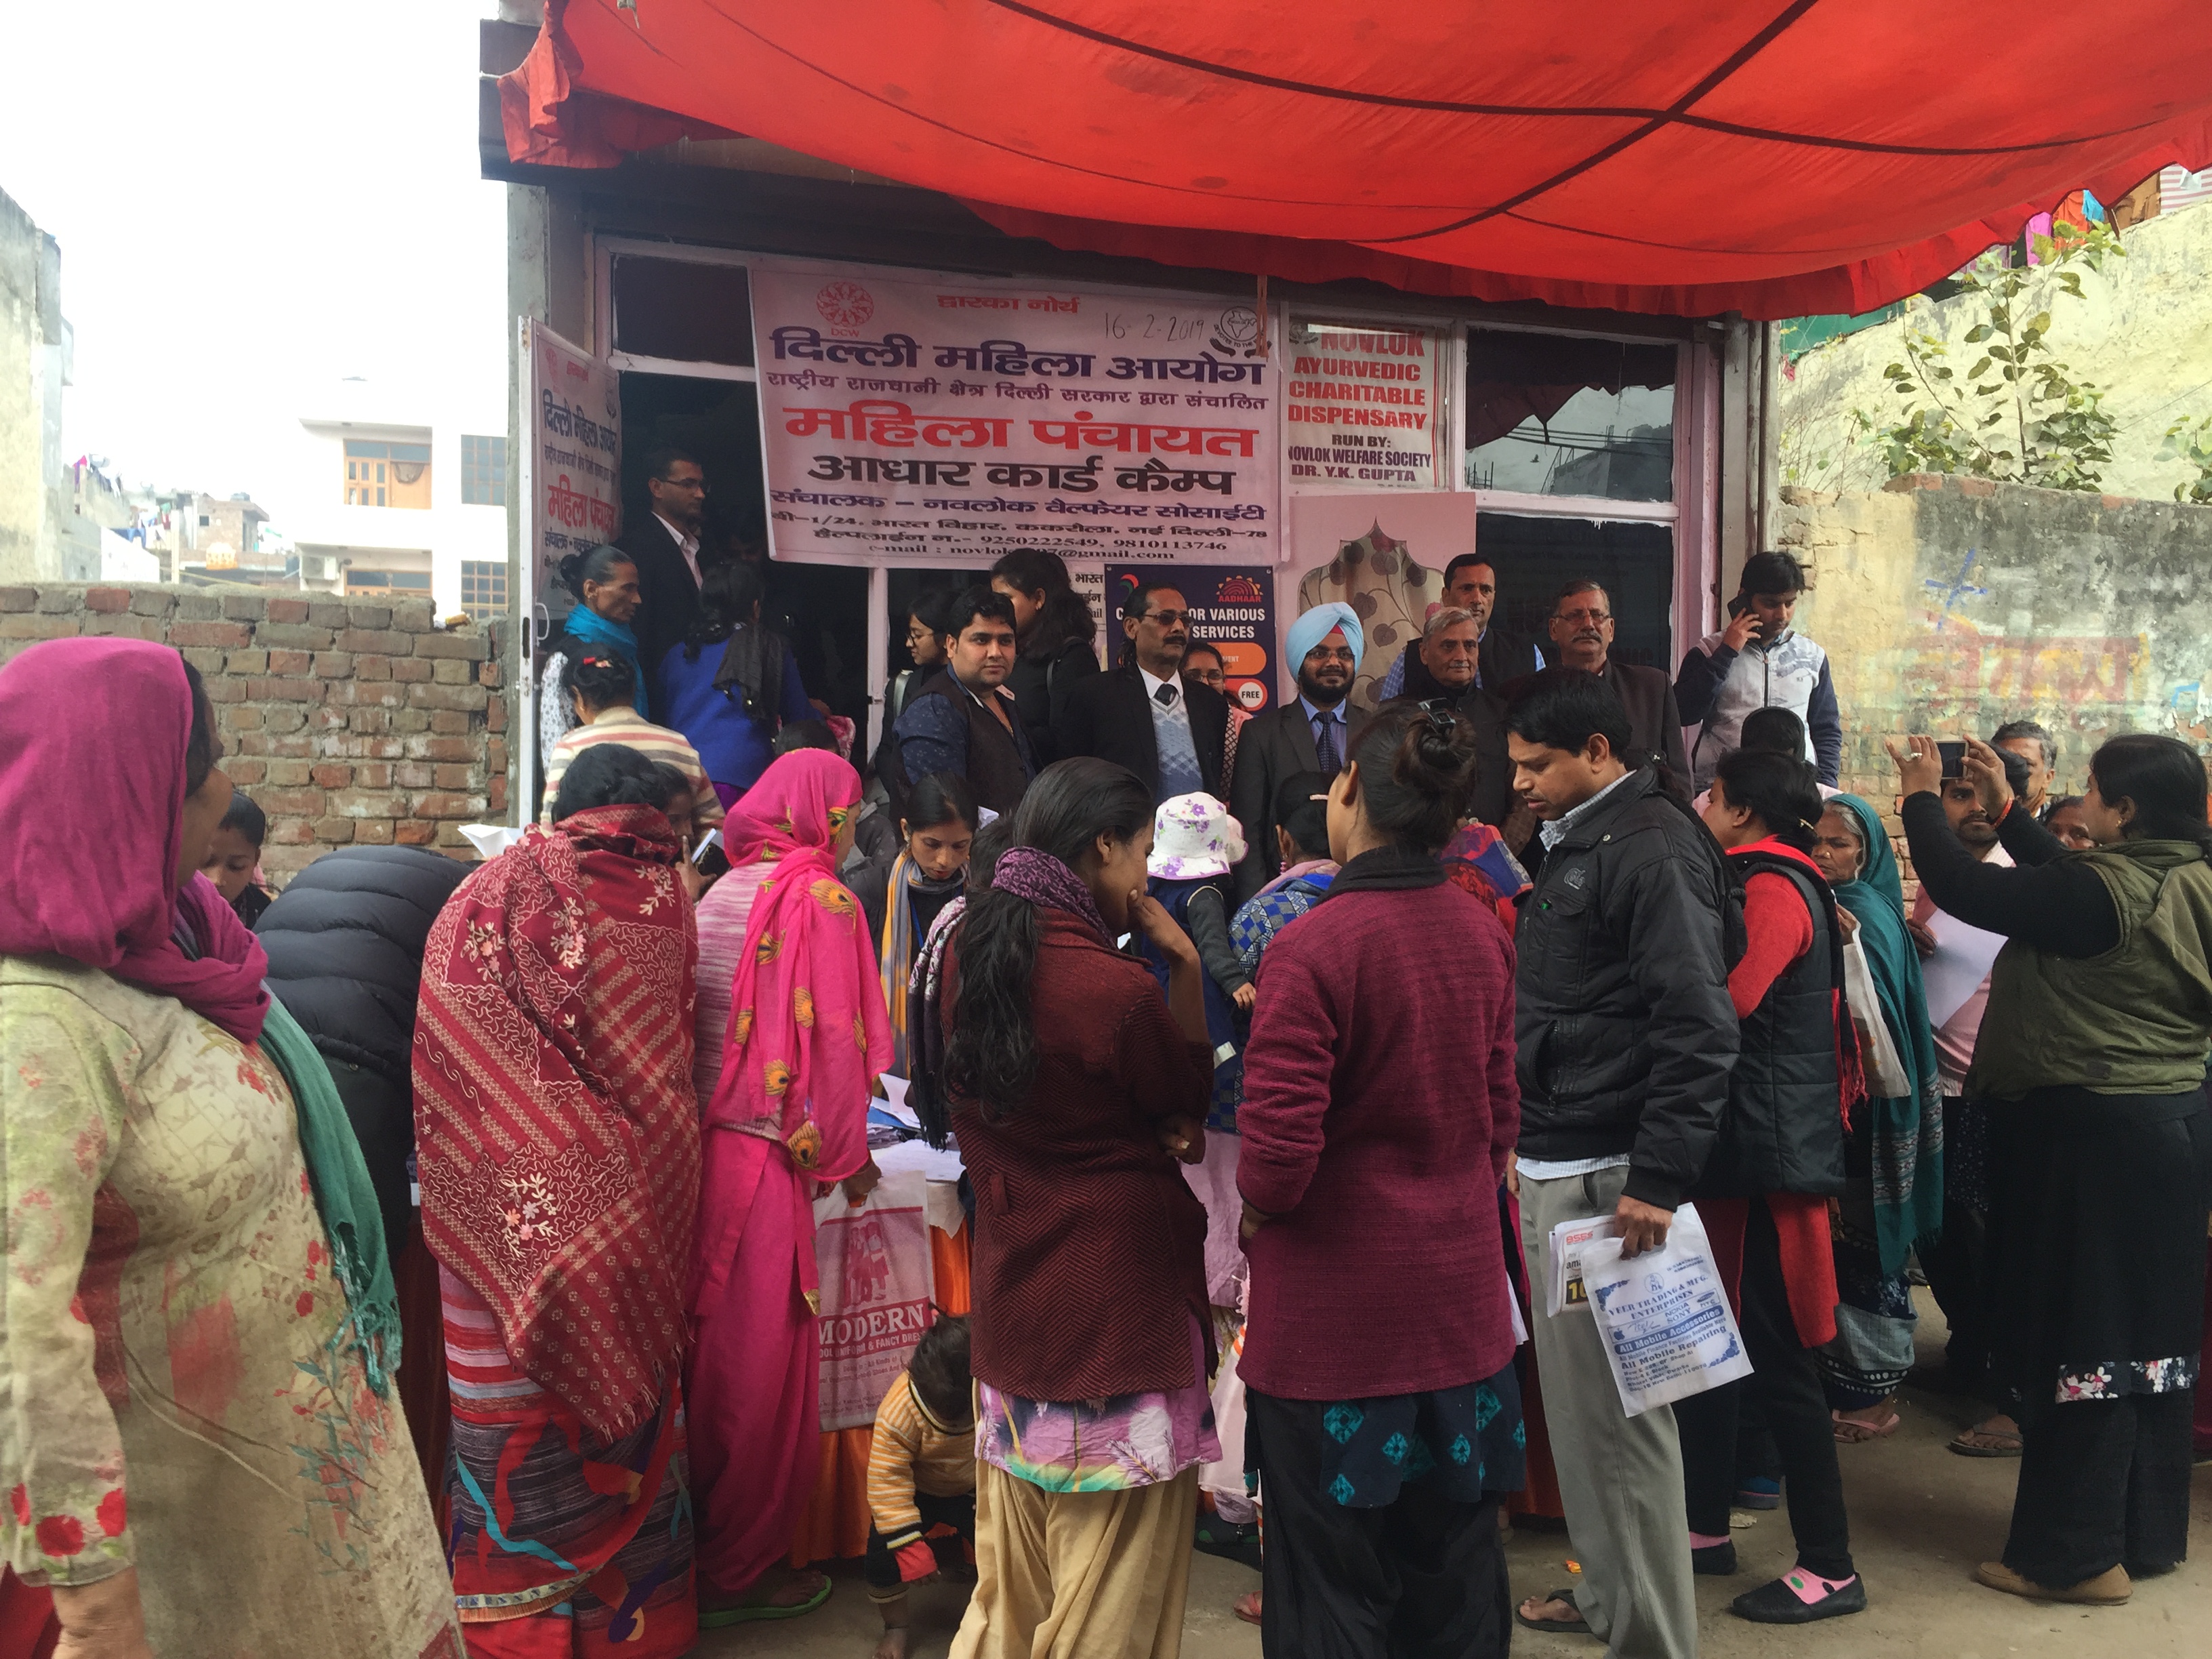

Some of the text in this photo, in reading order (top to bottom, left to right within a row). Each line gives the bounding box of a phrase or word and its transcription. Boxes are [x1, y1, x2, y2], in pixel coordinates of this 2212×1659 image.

[831, 328, 859, 337] DCW
[1322, 327, 1425, 357] NOVLOK
[769, 325, 1266, 385] दिल्ली महिला आयोग
[1294, 356, 1420, 382] AYURVEDIC
[766, 369, 1269, 409] राष्ट्रीय राजधानी क्षेत्र दिल्ली सरकार द्वारा संचालित
[1289, 381, 1425, 406] CHARITABLE
[782, 399, 1259, 457] महिला पंचायत
[1288, 404, 1427, 430] DISPENSARY
[1332, 434, 1391, 448] RUN BY:
[1288, 446, 1431, 468] NOVLOK WELFARE SOCIETY
[807, 455, 1237, 495] आधार कार्ड कैम्प
[1291, 464, 1416, 482] DR. Y.K. GUPTA
[548, 474, 588, 527] महिला
[770, 488, 888, 508] संचालक
[923, 496, 1039, 513] नवलोक
[1154, 502, 1267, 521] सोसाईटी
[869, 544, 927, 553] e-mail
[1113, 539, 1227, 550] 9810113746
[1075, 572, 1105, 583] भारत
[1189, 608, 1265, 621] OR VARIOUS
[1192, 625, 1255, 638] SERVICES
[1242, 691, 1260, 699] FREE
[1566, 1231, 1593, 1245] BSES
[1631, 1290, 1693, 1319] ENTERPRISES
[1637, 1287, 1677, 1308] TRADING
[1664, 1302, 1689, 1317] NOKIA
[1666, 1308, 1691, 1324] SONY
[819, 1303, 924, 1345] MODERN
[1620, 1345, 1633, 1353] All
[1634, 1333, 1667, 1349] Mobile
[1670, 1309, 1721, 1337] Accessories
[819, 1348, 832, 1358] OOL
[835, 1342, 866, 1357] UNIFORM
[868, 1341, 874, 1351] &
[876, 1335, 900, 1349] FANCY
[1622, 1361, 1637, 1370] All
[1639, 1349, 1675, 1366] Mobile
[1678, 1326, 1727, 1351] Repairing
